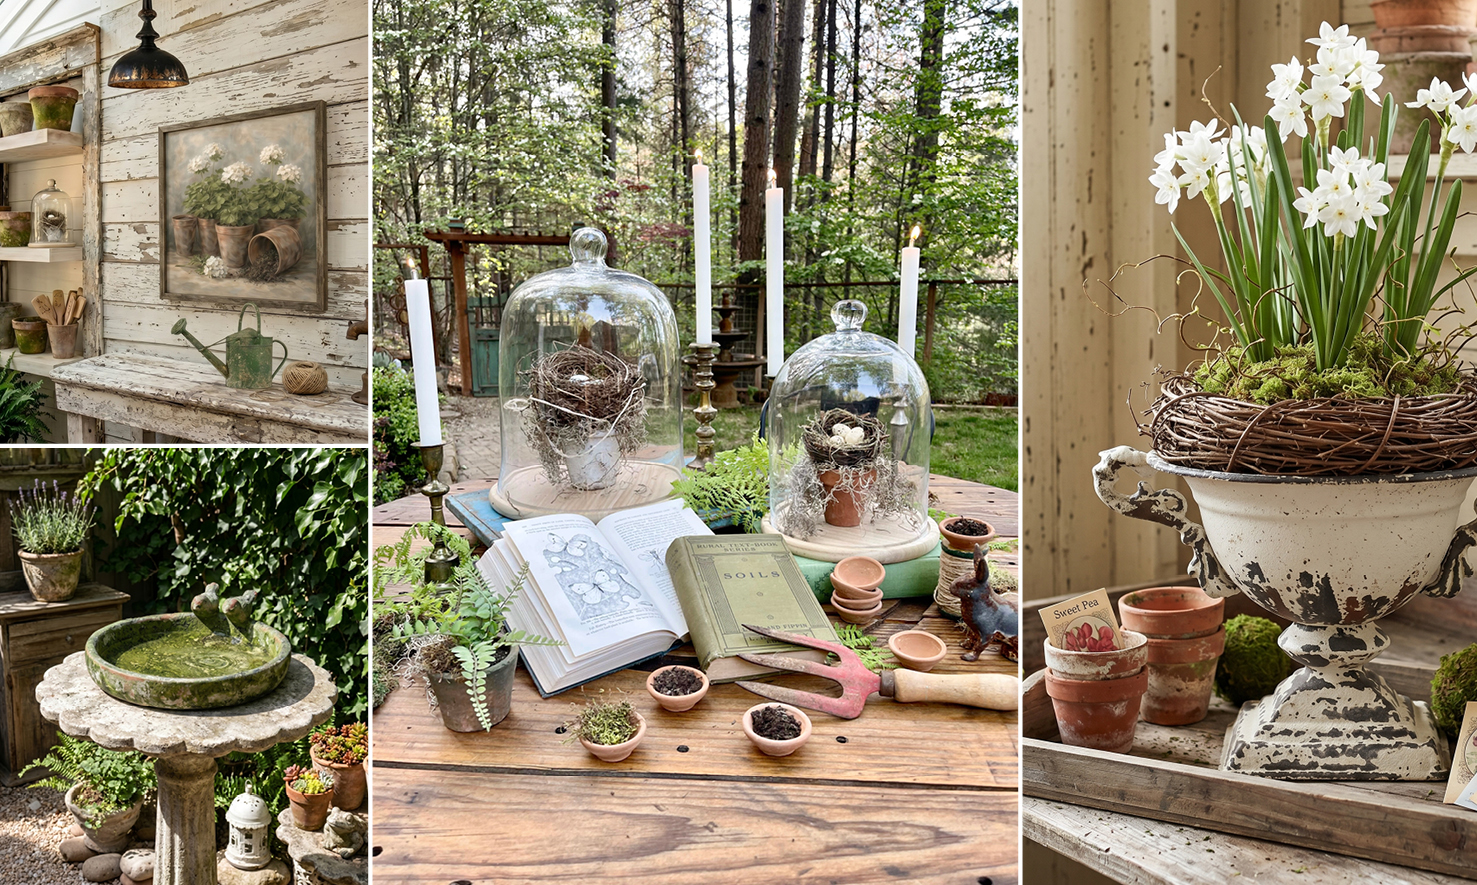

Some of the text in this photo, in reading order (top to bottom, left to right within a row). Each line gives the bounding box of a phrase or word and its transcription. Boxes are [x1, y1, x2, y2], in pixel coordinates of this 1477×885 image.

[723, 571, 780, 580] SOILS
[1053, 598, 1099, 620] Sweet Pea
